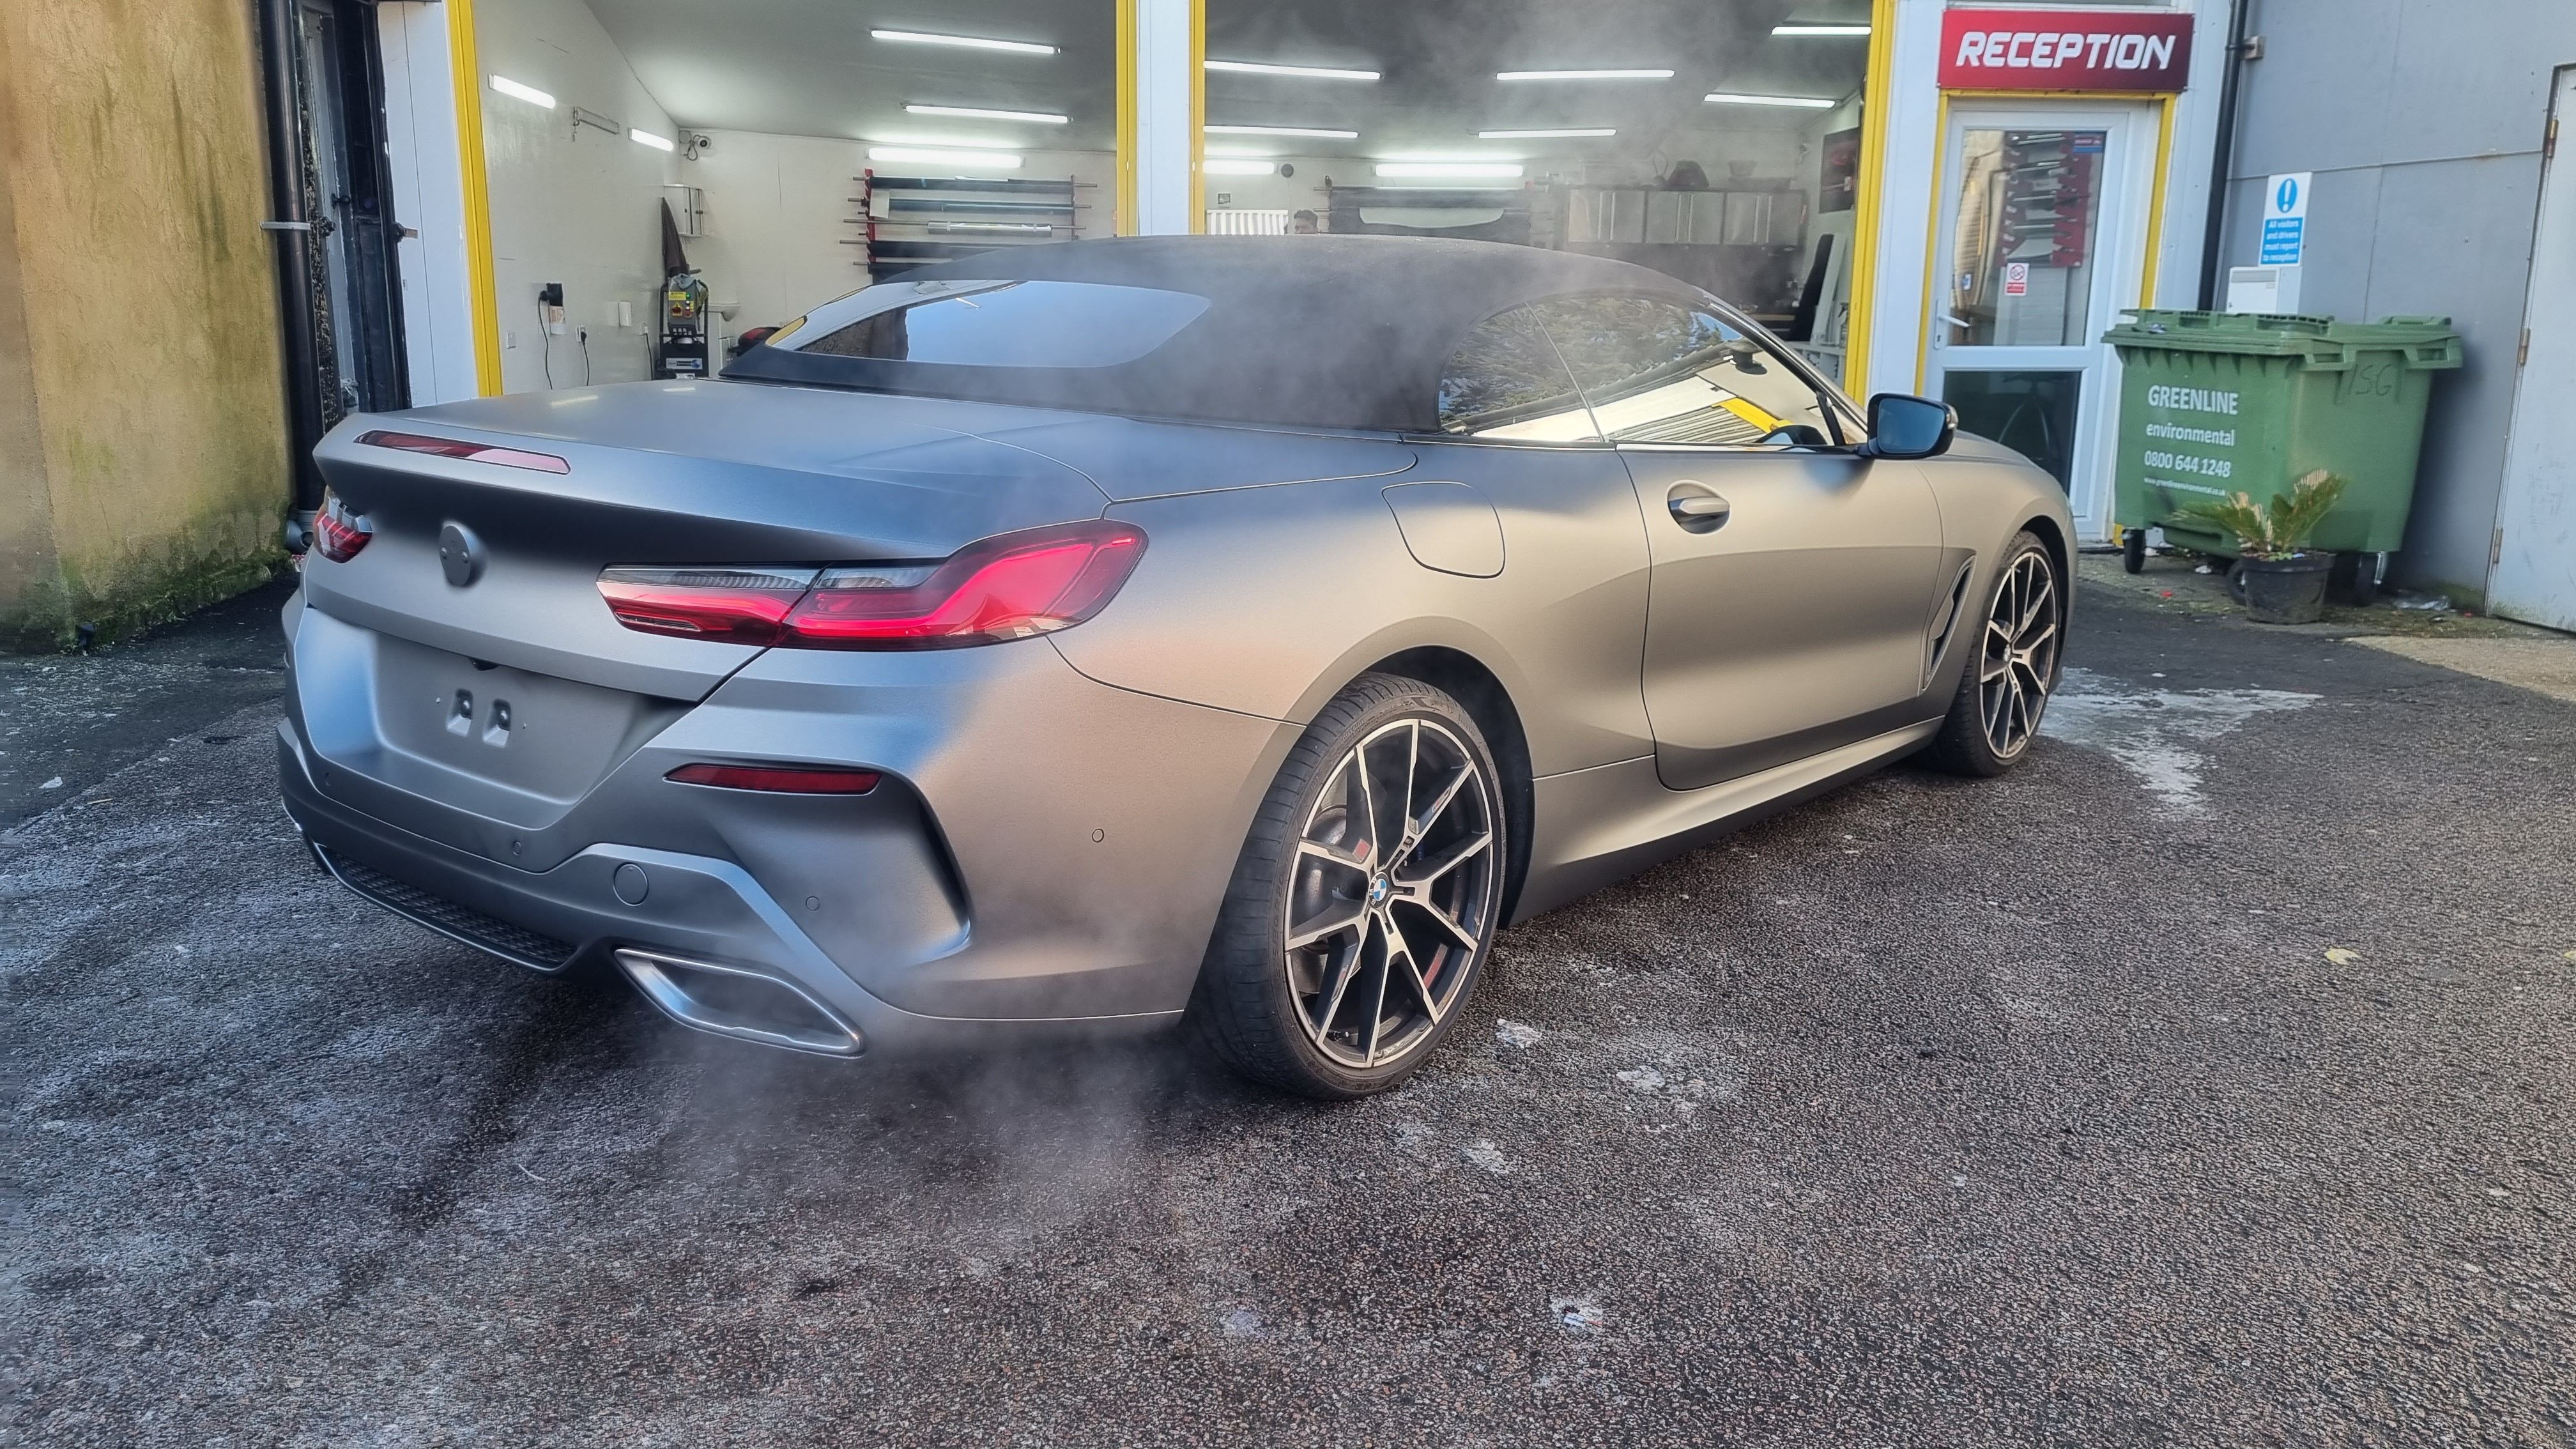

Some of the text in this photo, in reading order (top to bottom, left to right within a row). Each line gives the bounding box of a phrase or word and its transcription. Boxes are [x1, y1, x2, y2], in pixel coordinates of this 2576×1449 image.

[1955, 31, 2176, 70] RECEPTION
[2267, 232, 2278, 240] and
[2280, 242, 2298, 251] report
[2269, 253, 2297, 261] reception
[2148, 385, 2239, 415] GREENLINE
[2146, 422, 2235, 447] environmental
[2144, 450, 2232, 478] 0800 644 1248
